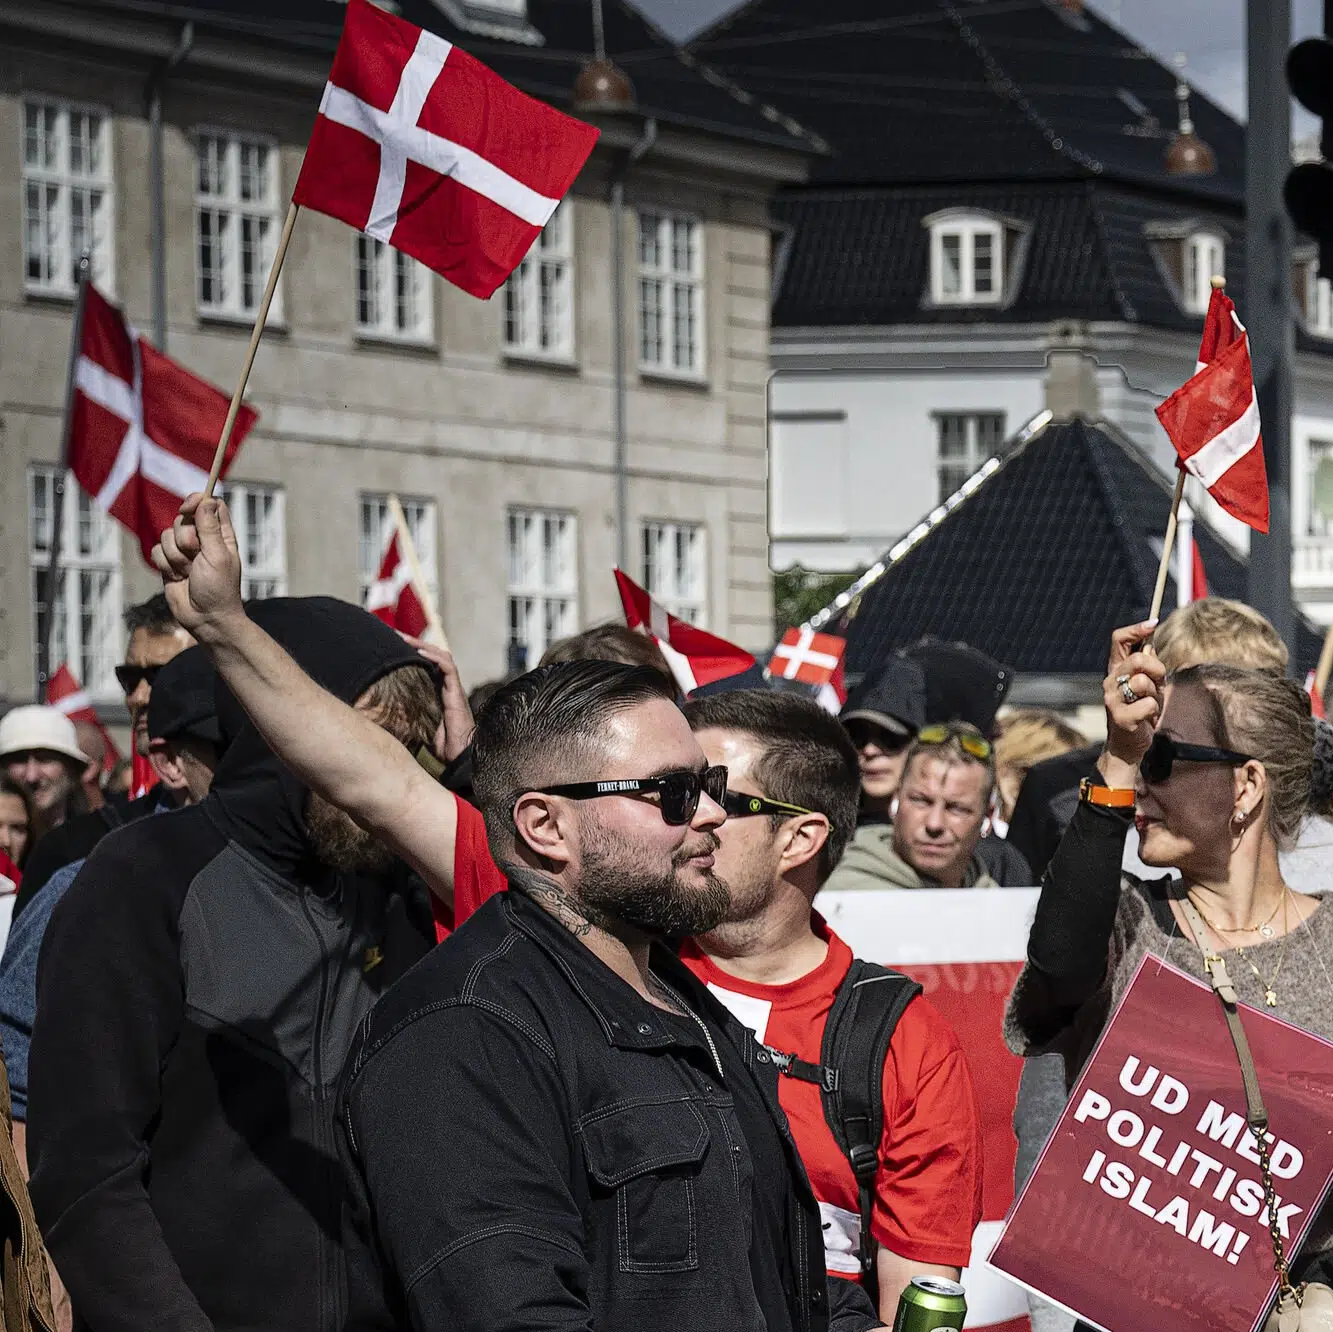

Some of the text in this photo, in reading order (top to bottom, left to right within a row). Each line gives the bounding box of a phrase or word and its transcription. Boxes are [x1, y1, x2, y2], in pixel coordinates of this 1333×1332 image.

[1073, 1088, 1304, 1239] POLITISK
[1118, 1054, 1304, 1180] UD MED
[1082, 1150, 1250, 1265] ISLAM!
